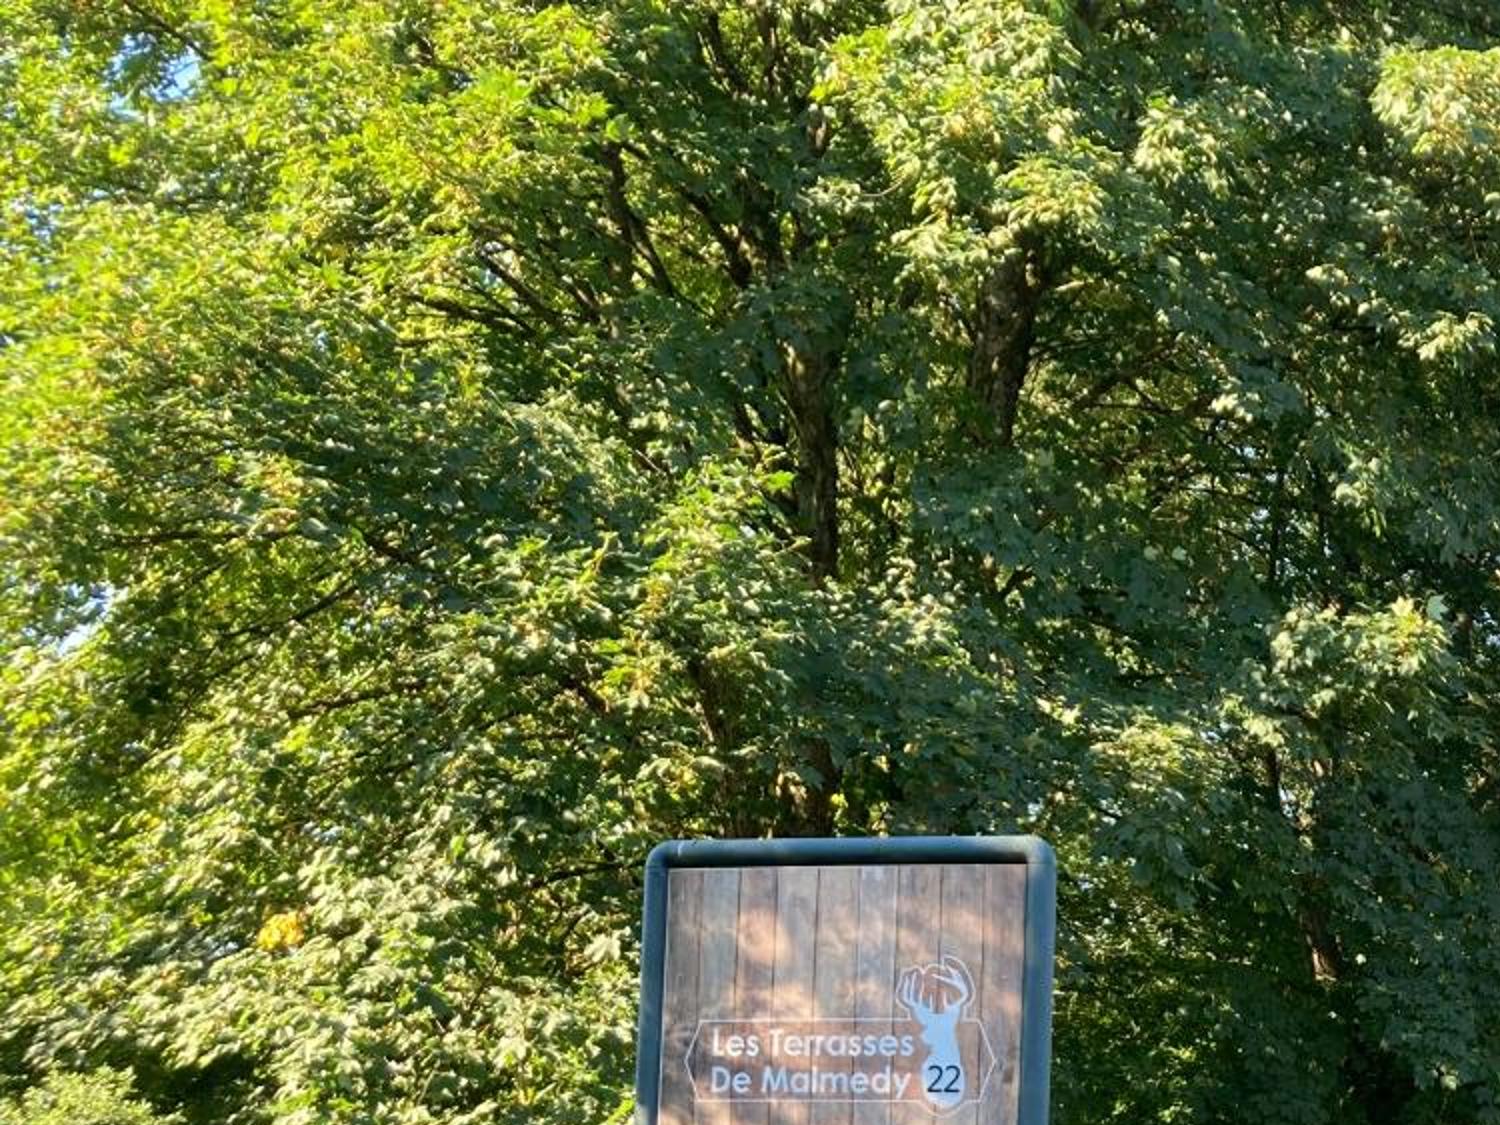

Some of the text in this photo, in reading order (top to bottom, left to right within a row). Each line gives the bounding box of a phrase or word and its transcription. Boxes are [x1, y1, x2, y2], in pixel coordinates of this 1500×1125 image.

[711, 1029, 914, 1057] Les Terrasses
[711, 1066, 911, 1097] De Malmedy
[926, 1065, 961, 1093] 22
